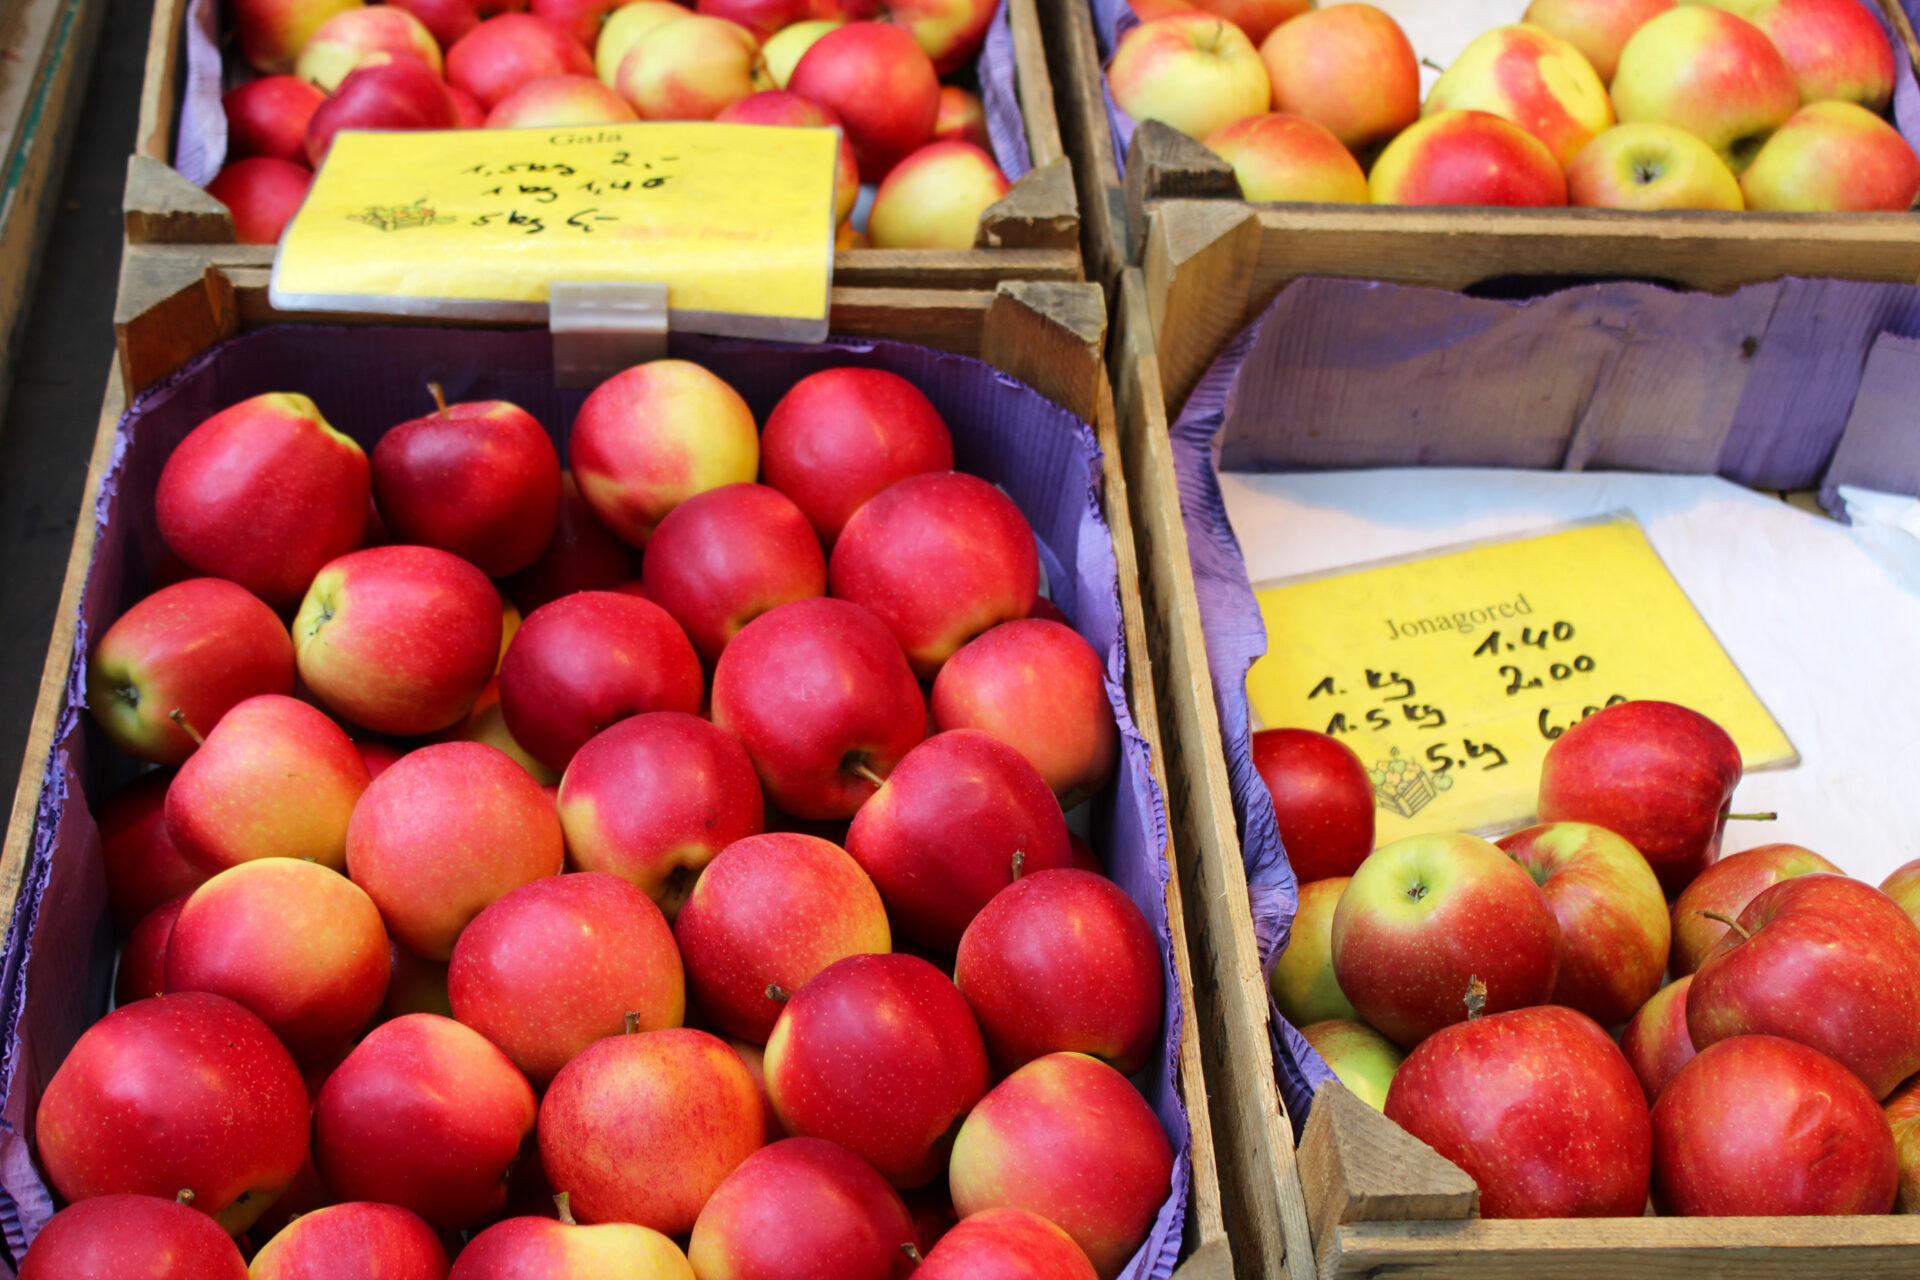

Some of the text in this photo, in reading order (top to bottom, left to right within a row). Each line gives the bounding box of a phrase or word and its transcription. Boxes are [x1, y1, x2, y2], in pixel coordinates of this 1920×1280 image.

[549, 131, 623, 146] Gala
[517, 184, 559, 204] kg
[471, 212, 504, 226] 5
[507, 209, 546, 235] kg
[1386, 592, 1534, 641] Jonagored
[1364, 667, 1416, 703] kg
[1472, 619, 1576, 659] 1.40
[1402, 703, 1447, 730] kg
[1498, 654, 1597, 698] 2.00
